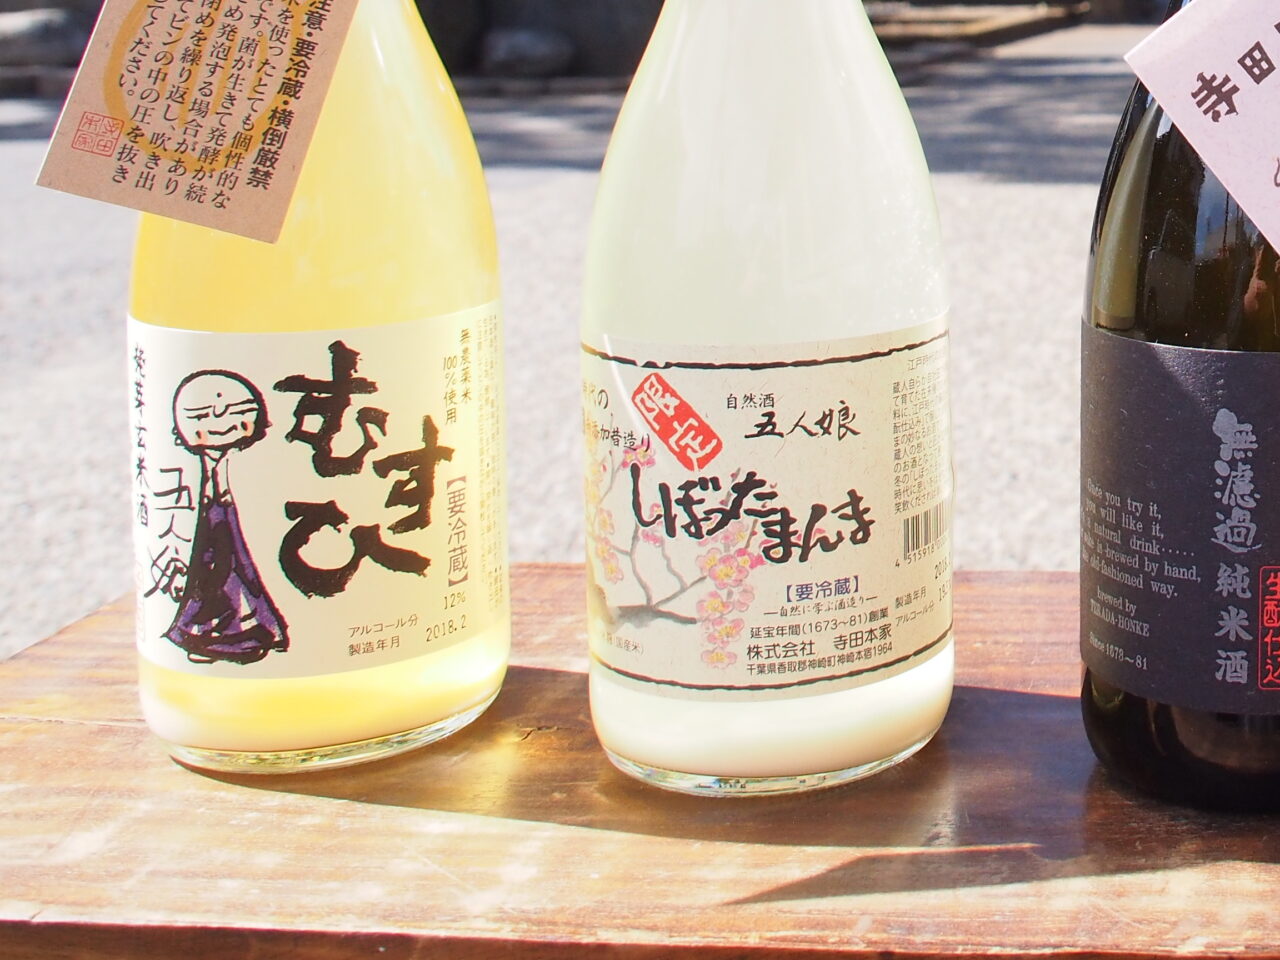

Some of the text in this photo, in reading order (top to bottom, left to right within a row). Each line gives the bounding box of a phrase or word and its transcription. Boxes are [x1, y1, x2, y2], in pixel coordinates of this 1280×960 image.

[726, 392, 775, 410] 自然酒
[744, 400, 862, 441] 五人娘
[1105, 491, 1120, 507] you
[1127, 497, 1143, 516] try
[1149, 502, 1162, 520] it,
[1094, 521, 1121, 544] natural
[1100, 506, 1116, 524] will
[1122, 512, 1143, 533] like
[1151, 521, 1164, 539] it,
[1144, 557, 1159, 577] by
[1164, 561, 1201, 583] hand,
[1150, 580, 1178, 600] way.
[349, 590, 467, 638] アルコール分 12%
[1125, 599, 1137, 617] by
[348, 635, 401, 657] 製造年月
[746, 623, 893, 661] 株式会社 寺田本家
